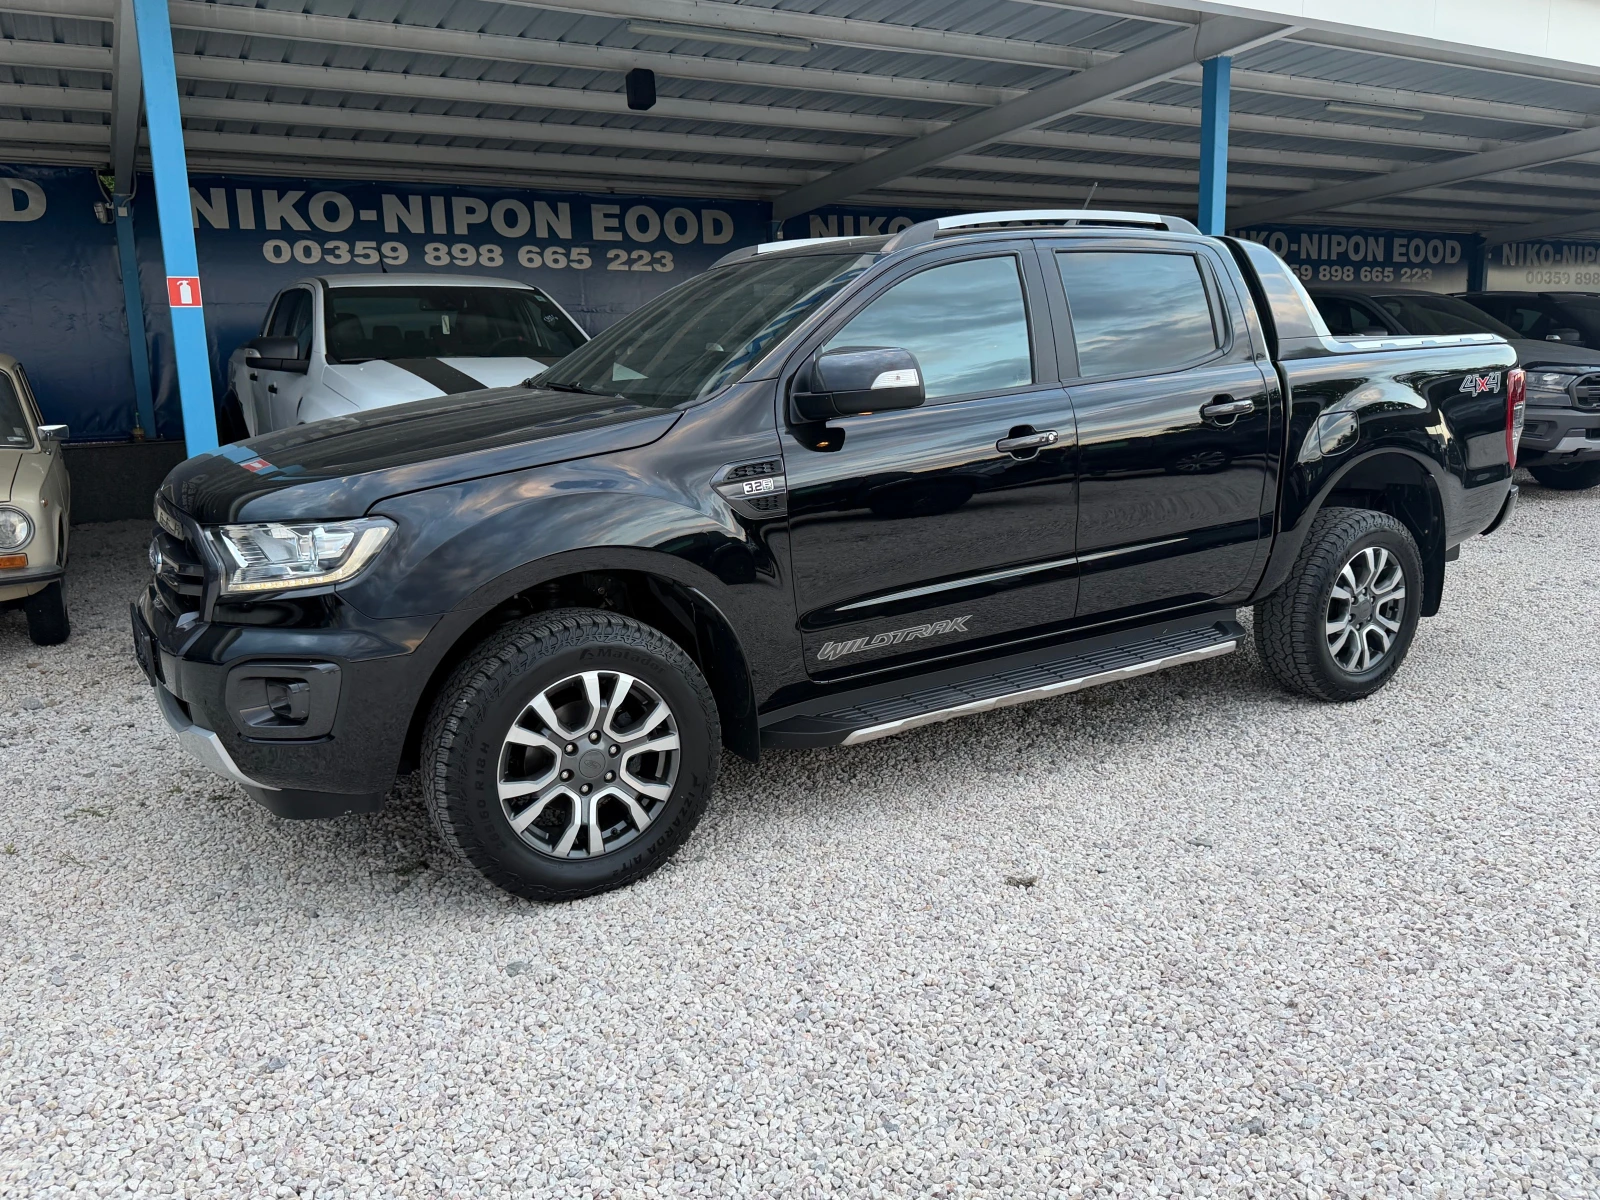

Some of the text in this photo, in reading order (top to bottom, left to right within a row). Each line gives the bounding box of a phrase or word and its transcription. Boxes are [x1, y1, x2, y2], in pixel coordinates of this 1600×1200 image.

[189, 186, 735, 245] NIKO-NIPON EOOD
[262, 239, 675, 273] 00359 898 665 223
[1229, 230, 1462, 265] O-NIPON EOOD
[1318, 265, 1355, 282] 898
[1360, 266, 1394, 283] 665
[1459, 371, 1501, 397] 4x4
[817, 614, 973, 661] WILDTRAK
